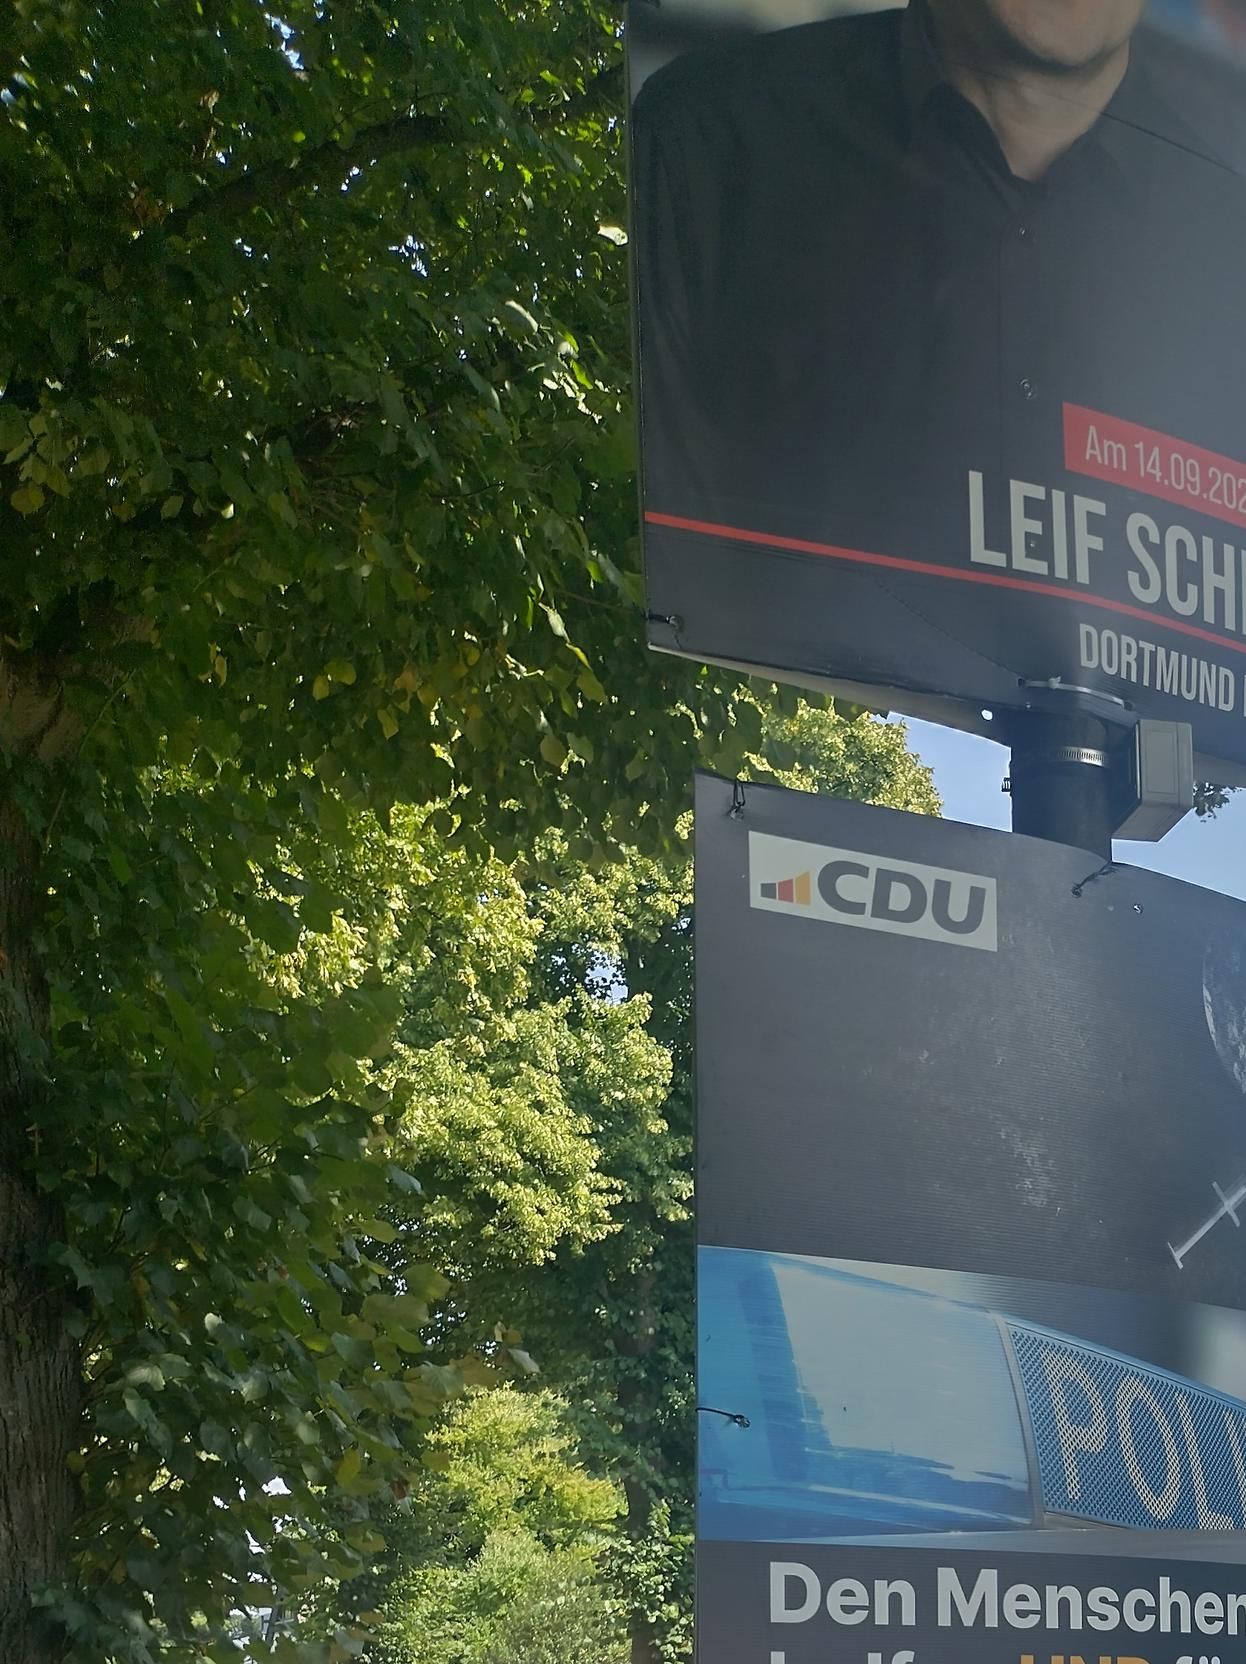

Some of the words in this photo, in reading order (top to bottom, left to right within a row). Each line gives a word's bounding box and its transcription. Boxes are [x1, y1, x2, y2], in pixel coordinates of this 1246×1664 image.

[1085, 425, 1126, 471] Am
[968, 470, 1106, 585] LEIF
[1079, 623, 1235, 712] DORTMUND
[816, 860, 986, 934] CDU
[769, 1561, 916, 1626] Den
